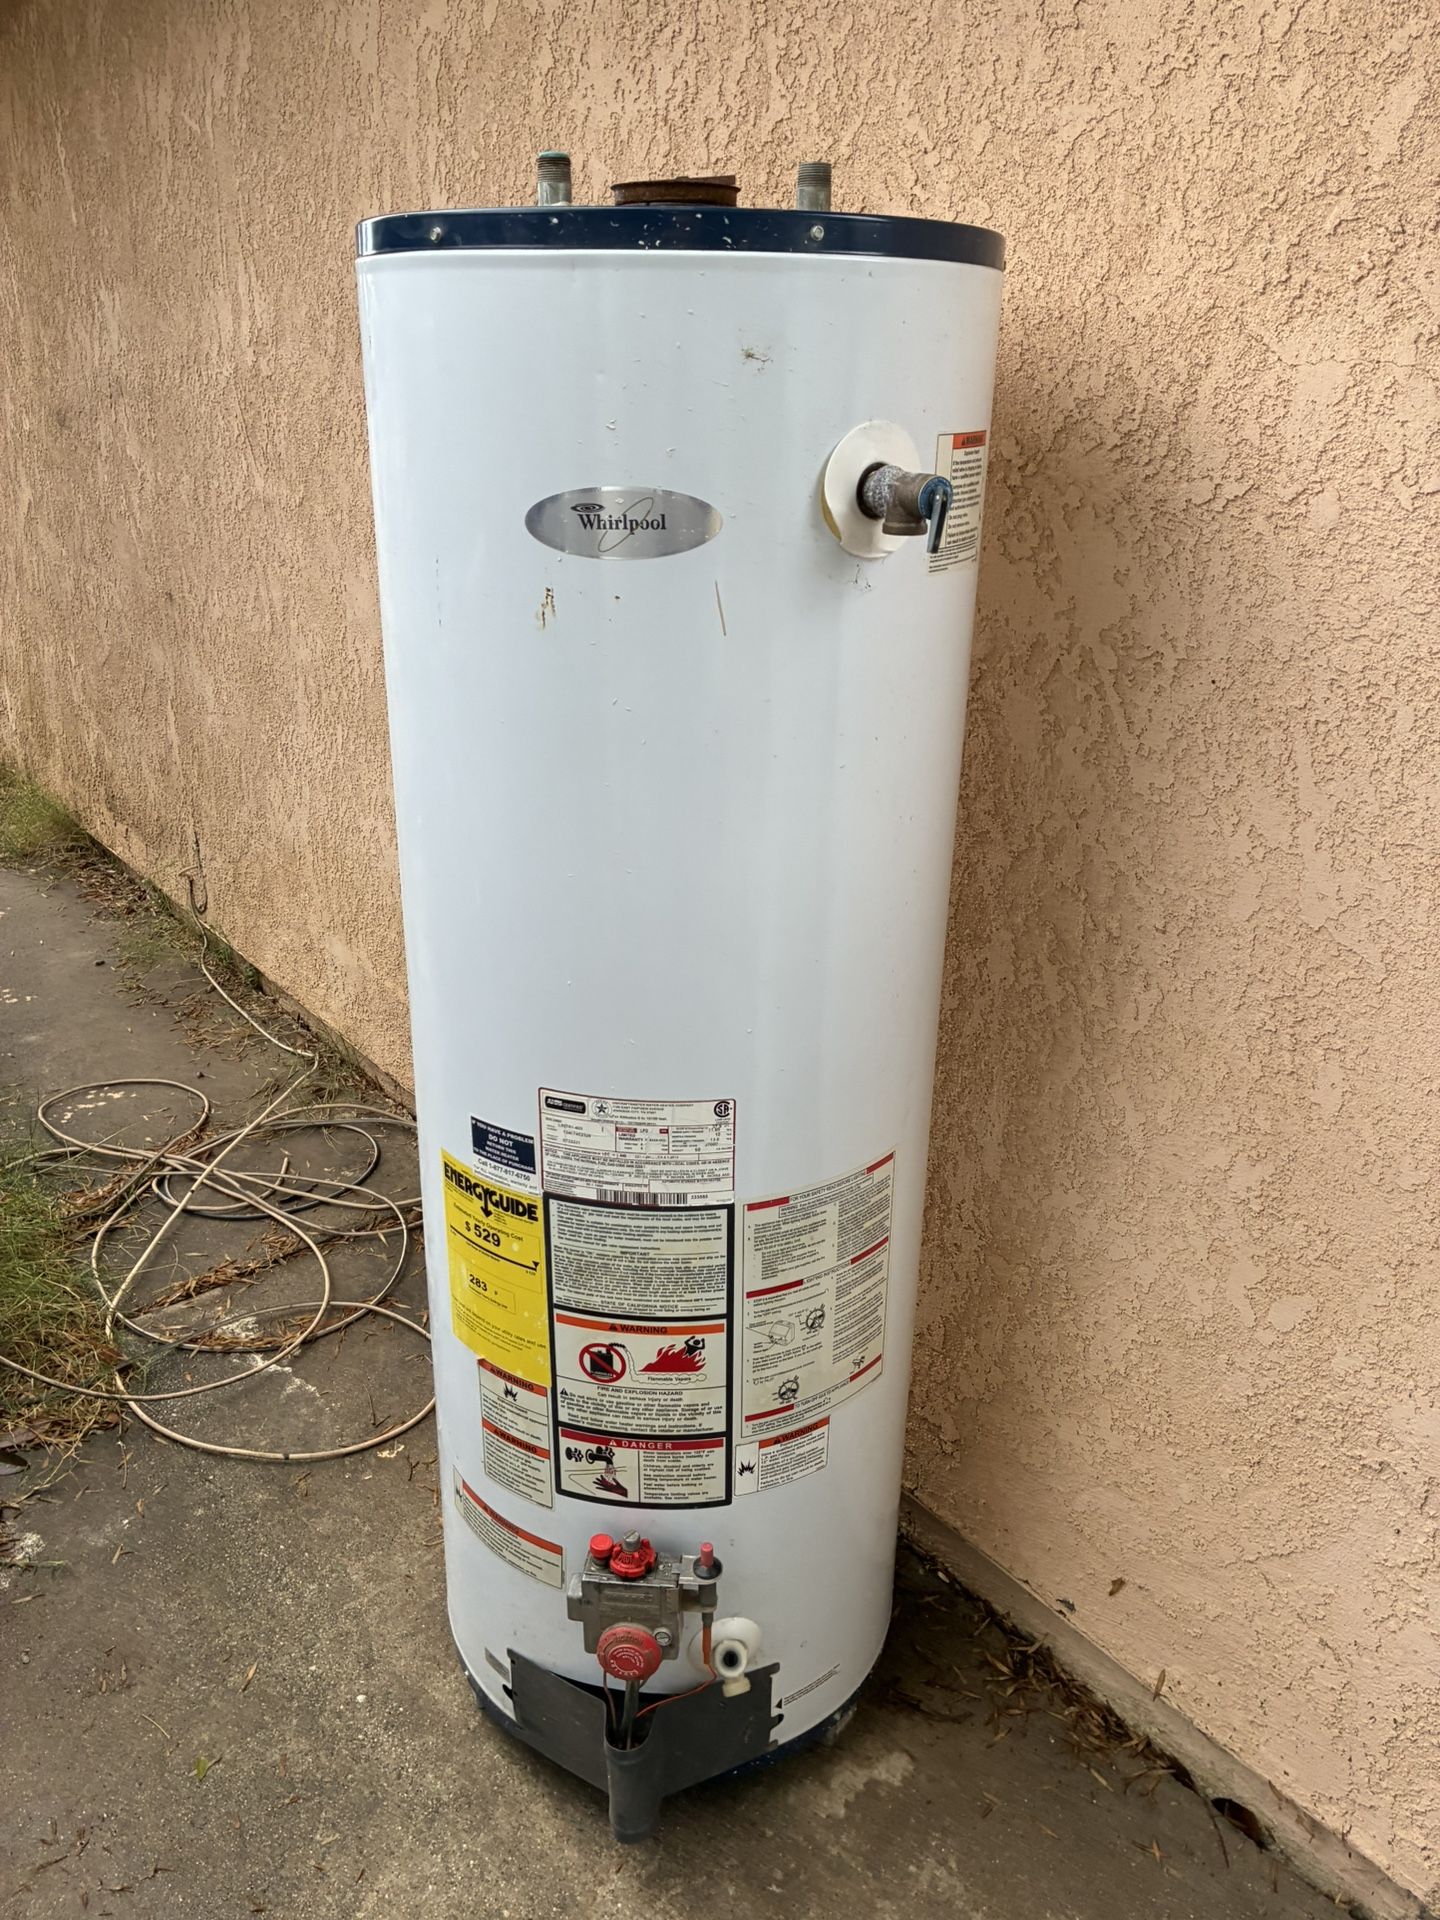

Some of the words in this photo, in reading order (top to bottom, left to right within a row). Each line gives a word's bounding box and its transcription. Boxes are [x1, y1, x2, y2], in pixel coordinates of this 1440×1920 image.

[577, 513, 667, 535] Whirlpool
[488, 1134, 498, 1142] DO
[500, 1138, 514, 1147] NOT
[478, 1158, 488, 1167] Call
[444, 1160, 538, 1222] ENERGYGUIDE
[465, 1220, 472, 1232] $
[474, 1223, 501, 1248] 529
[469, 1273, 488, 1291] 283
[620, 1324, 668, 1334] WARNING
[782, 1422, 818, 1442] WARNING
[622, 1440, 672, 1450] DANGER
